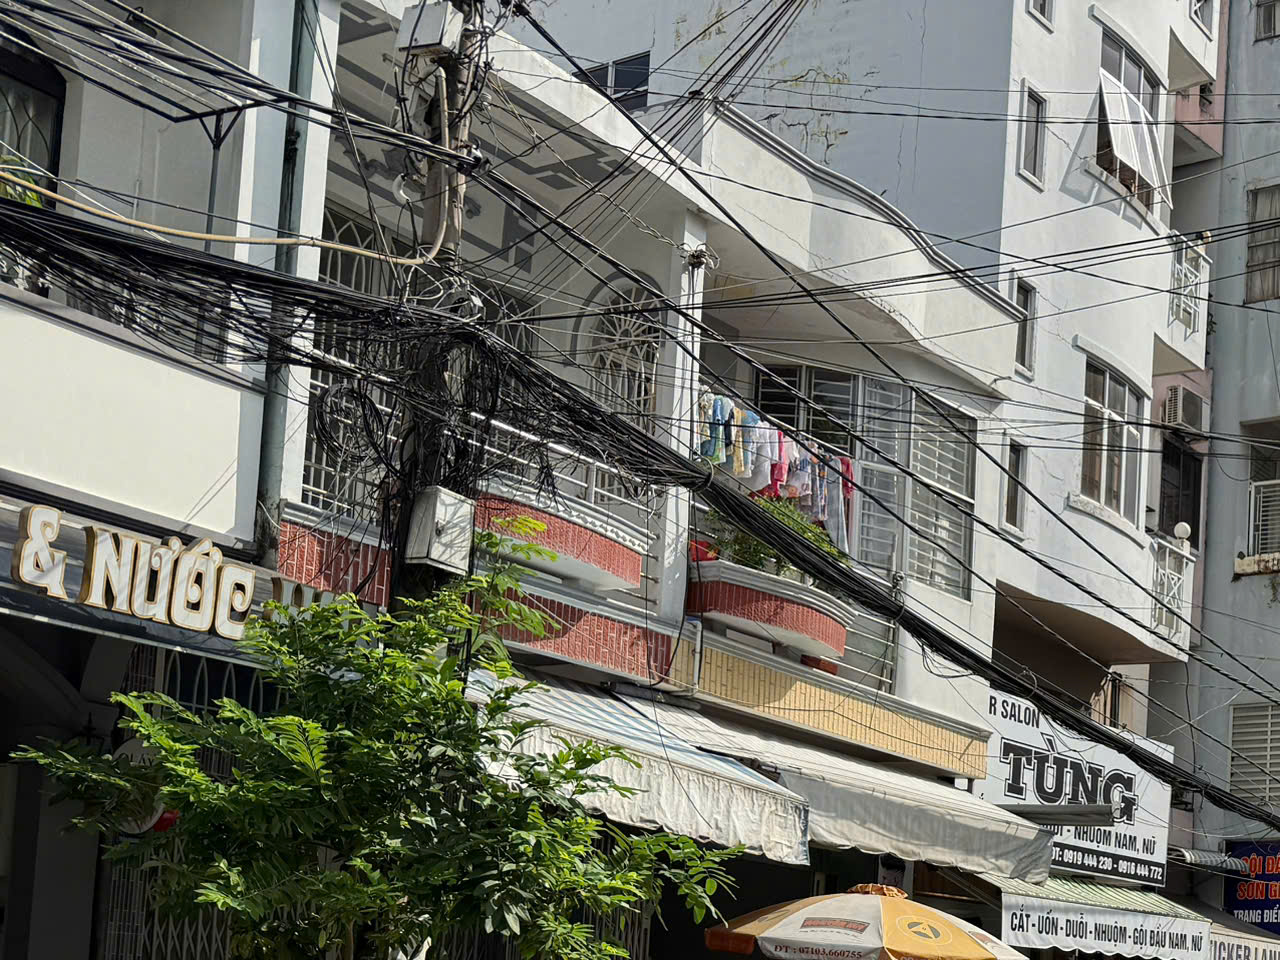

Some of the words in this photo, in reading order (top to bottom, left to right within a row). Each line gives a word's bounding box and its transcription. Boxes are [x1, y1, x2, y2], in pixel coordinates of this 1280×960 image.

[14, 504, 68, 600] &
[81, 536, 256, 641] NƯỚC
[1001, 699, 1041, 729] SALON
[1000, 732, 1139, 826] TÙNG
[1063, 848, 1083, 865] 0919
[1083, 852, 1098, 868] 444
[1098, 855, 1113, 871] 230
[1136, 863, 1150, 878] 444
[1150, 865, 1163, 880] 772
[1010, 904, 1031, 933] CẮT
[1037, 908, 1059, 937] UỐN
[1094, 921, 1127, 947] NHUỘM
[1133, 924, 1148, 950] GỘI
[1149, 923, 1167, 949] ĐẦU
[1233, 909, 1262, 923] TRANG
